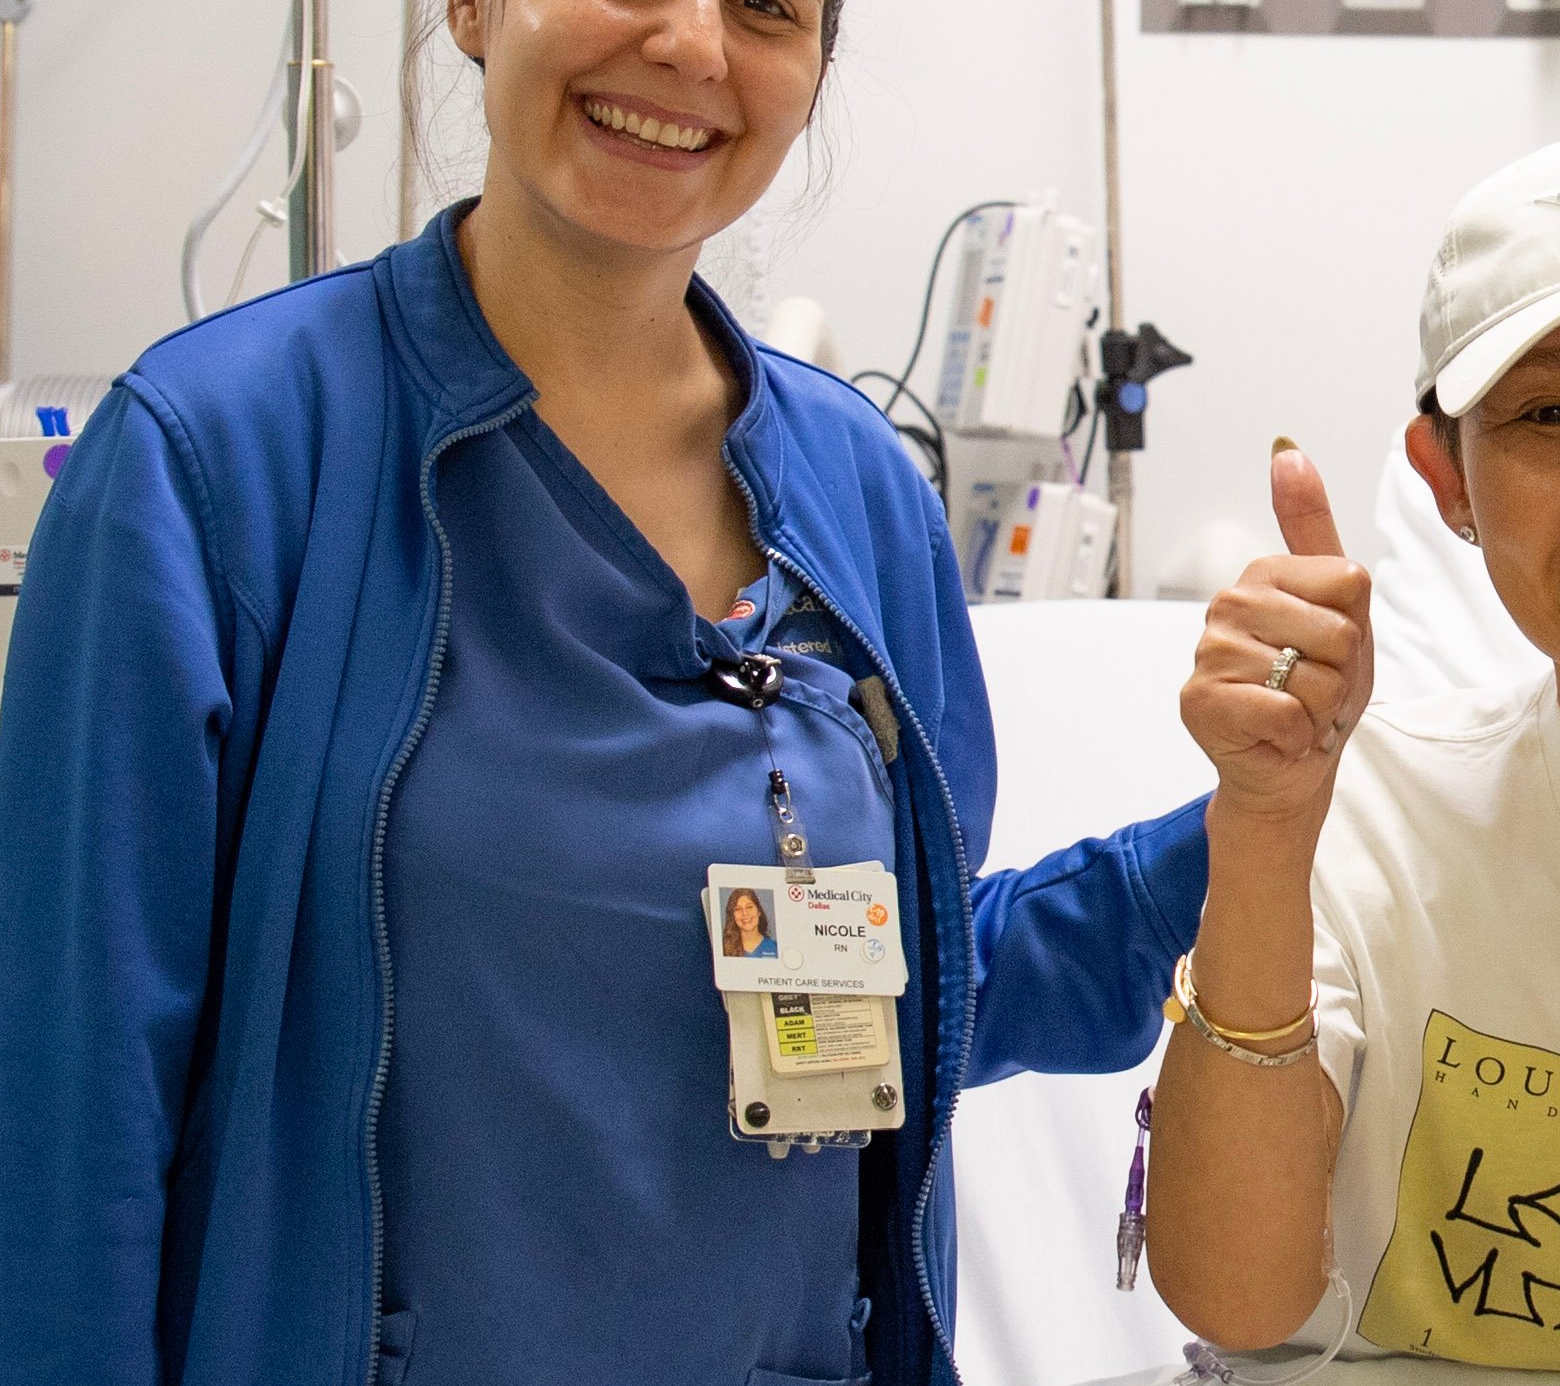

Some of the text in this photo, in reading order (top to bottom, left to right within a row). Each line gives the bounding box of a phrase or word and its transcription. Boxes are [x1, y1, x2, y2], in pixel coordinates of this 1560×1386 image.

[807, 889, 873, 905] Medical City
[808, 902, 831, 911] Dallas
[814, 924, 867, 938] NICOLE
[834, 943, 848, 953] RN
[758, 977, 865, 990] PATIENT CARE SERVICES
[780, 1005, 805, 1014] BLACK
[784, 1019, 805, 1027] ADAM
[786, 1032, 807, 1040] MERT
[791, 1044, 806, 1053] RRT
